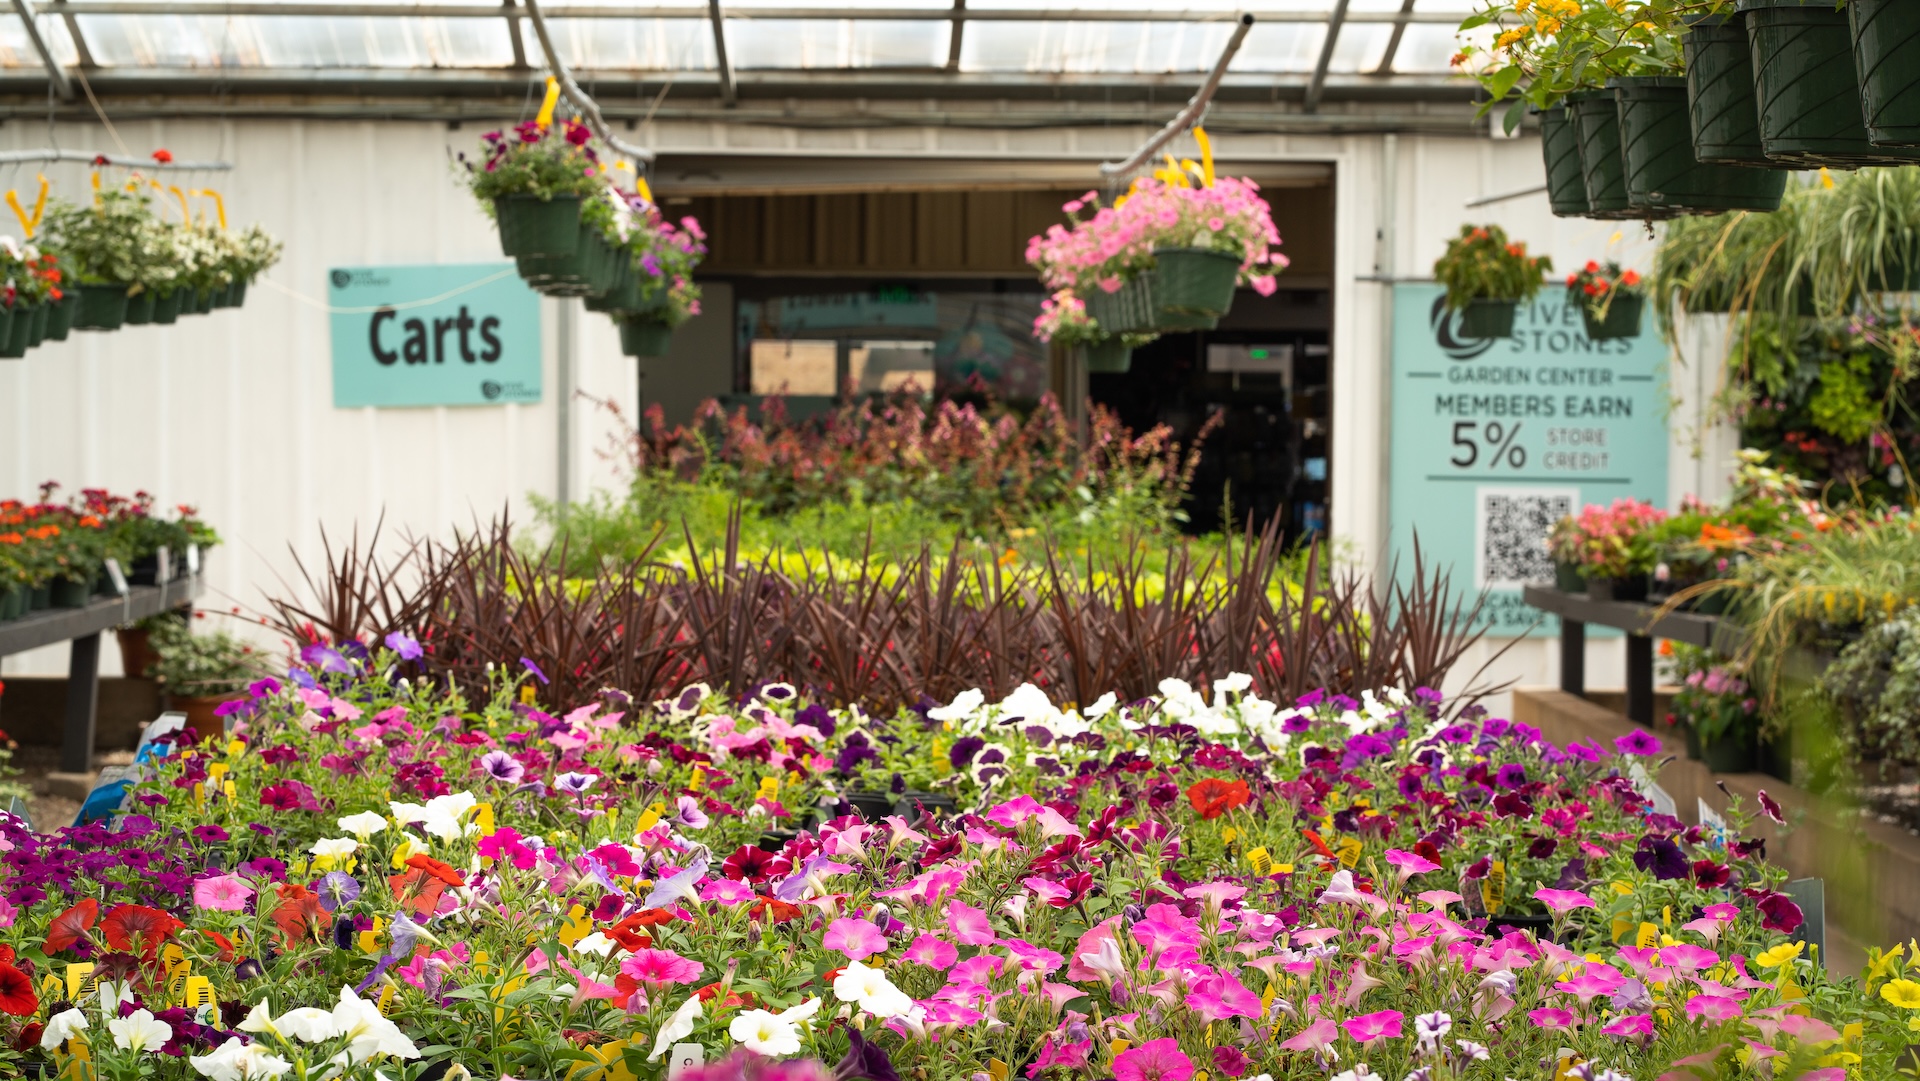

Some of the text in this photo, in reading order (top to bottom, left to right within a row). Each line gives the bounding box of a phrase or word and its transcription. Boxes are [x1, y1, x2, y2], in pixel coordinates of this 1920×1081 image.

[369, 303, 503, 367] Carts
[1448, 366, 1614, 387] GARDEN CENTER
[1435, 394, 1633, 418] MEMBERS EARN
[1450, 421, 1526, 469] 5%
[1546, 427, 1607, 447] STORE
[1542, 451, 1610, 471] CREDIT
